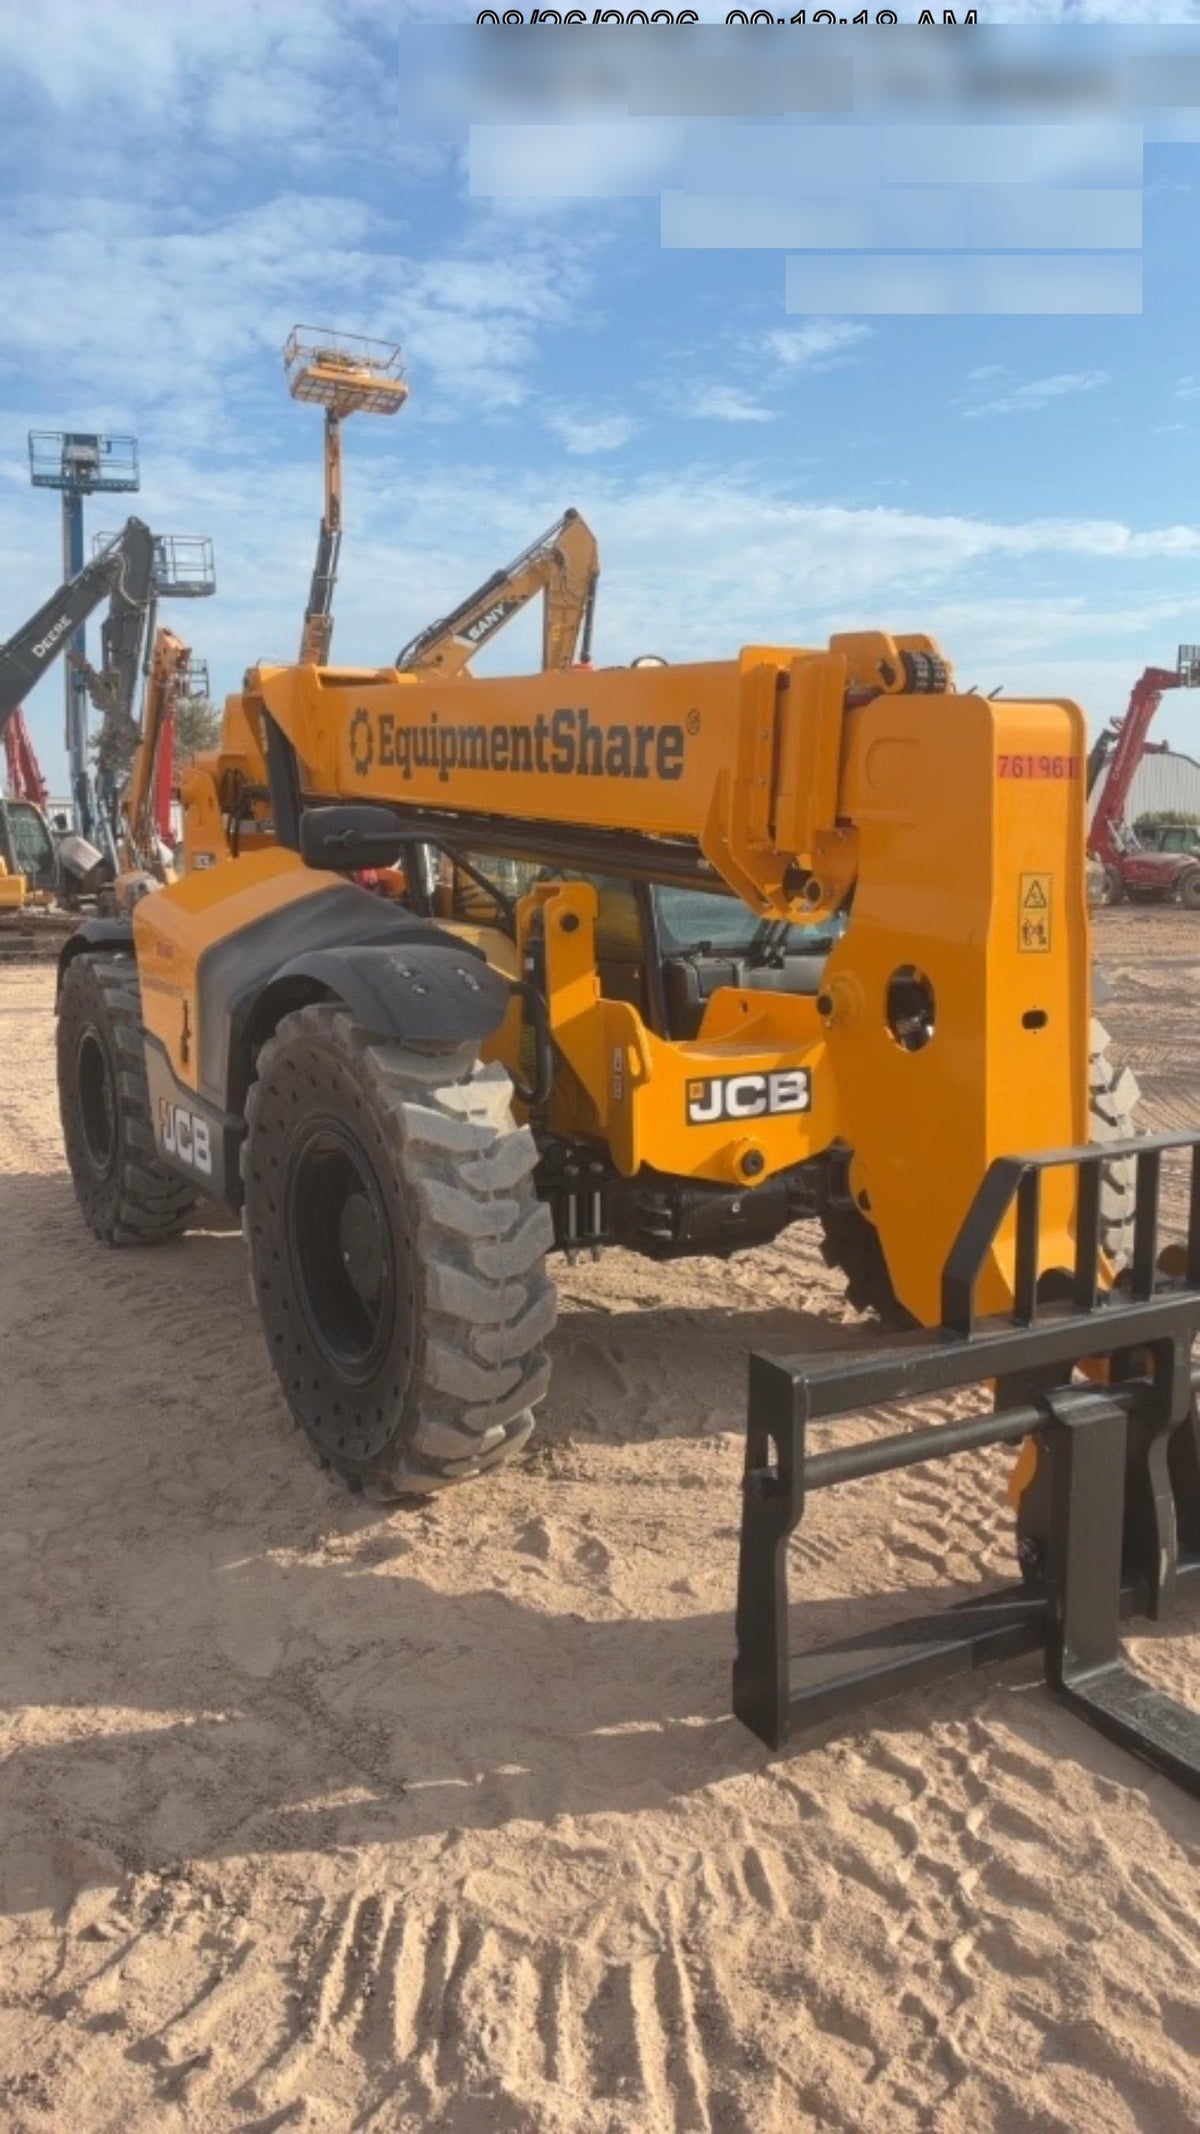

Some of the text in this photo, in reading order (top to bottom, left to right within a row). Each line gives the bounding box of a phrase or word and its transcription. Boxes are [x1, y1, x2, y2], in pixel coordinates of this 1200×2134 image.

[32, 614, 72, 658] DEERE
[468, 603, 504, 641] SANY
[997, 755, 1073, 779] 761961
[688, 1070, 809, 1122] JCB
[161, 1103, 212, 1174] JCB
